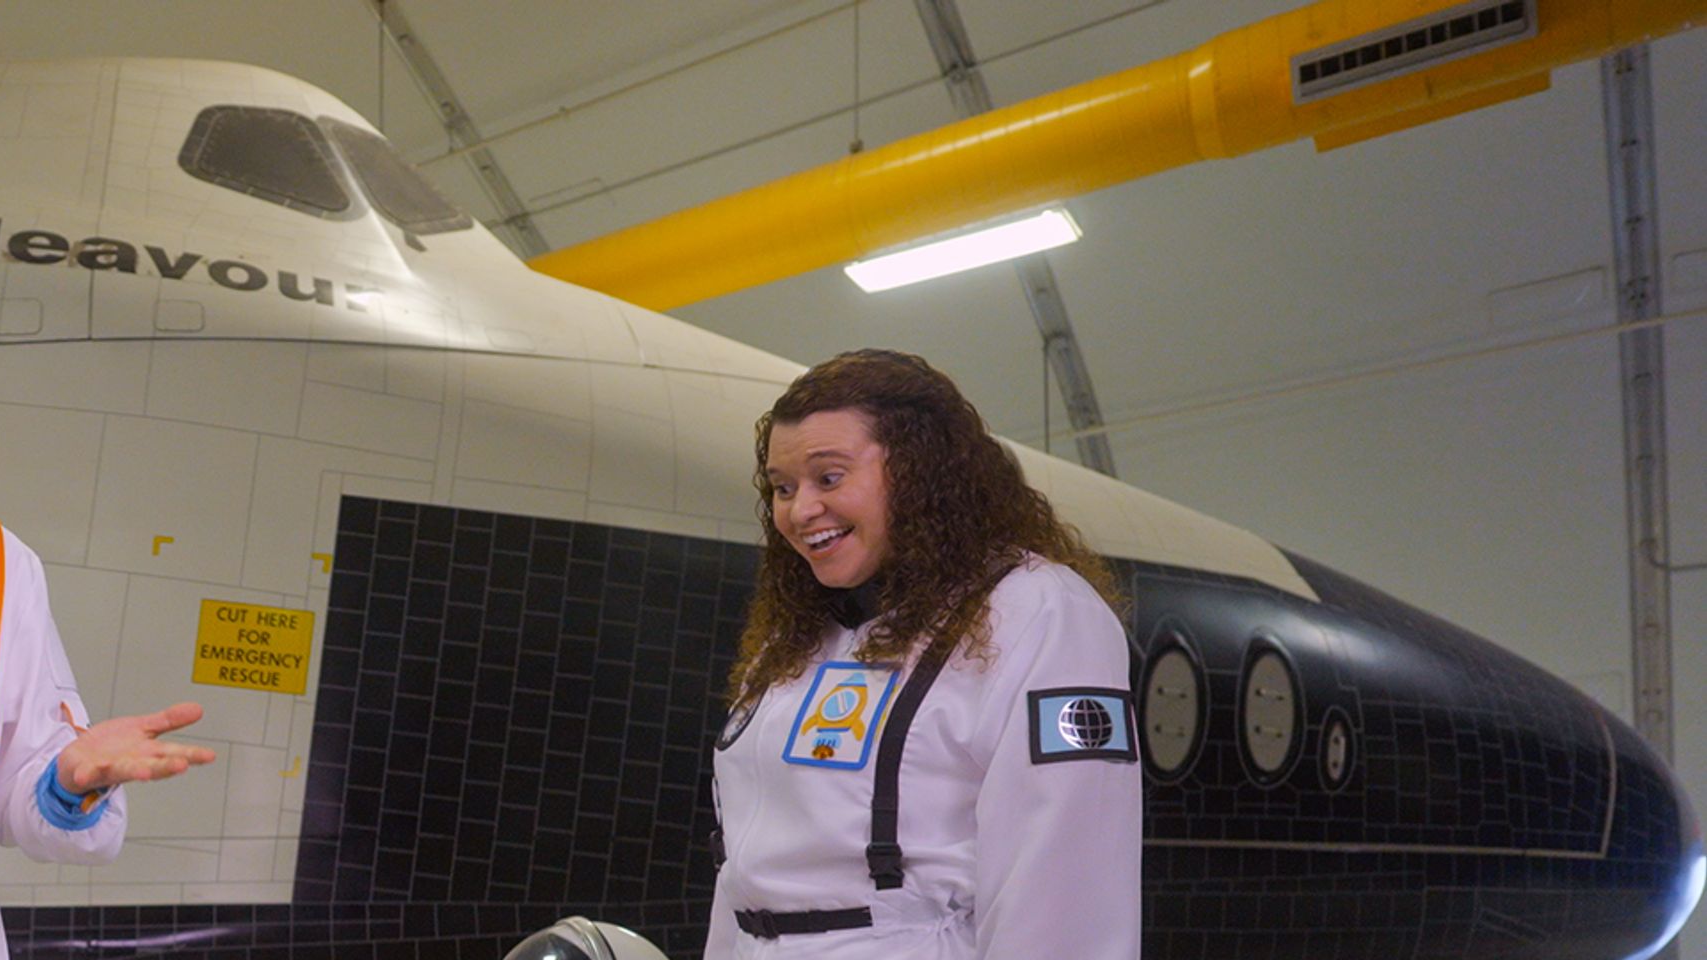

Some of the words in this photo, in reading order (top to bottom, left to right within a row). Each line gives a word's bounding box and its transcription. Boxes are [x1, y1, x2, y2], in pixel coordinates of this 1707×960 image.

[216, 606, 248, 623] CUT
[257, 611, 299, 630] HERE
[237, 629, 271, 645] FOR
[200, 643, 303, 670] EMERGENCY
[218, 666, 282, 687] RESCUE
